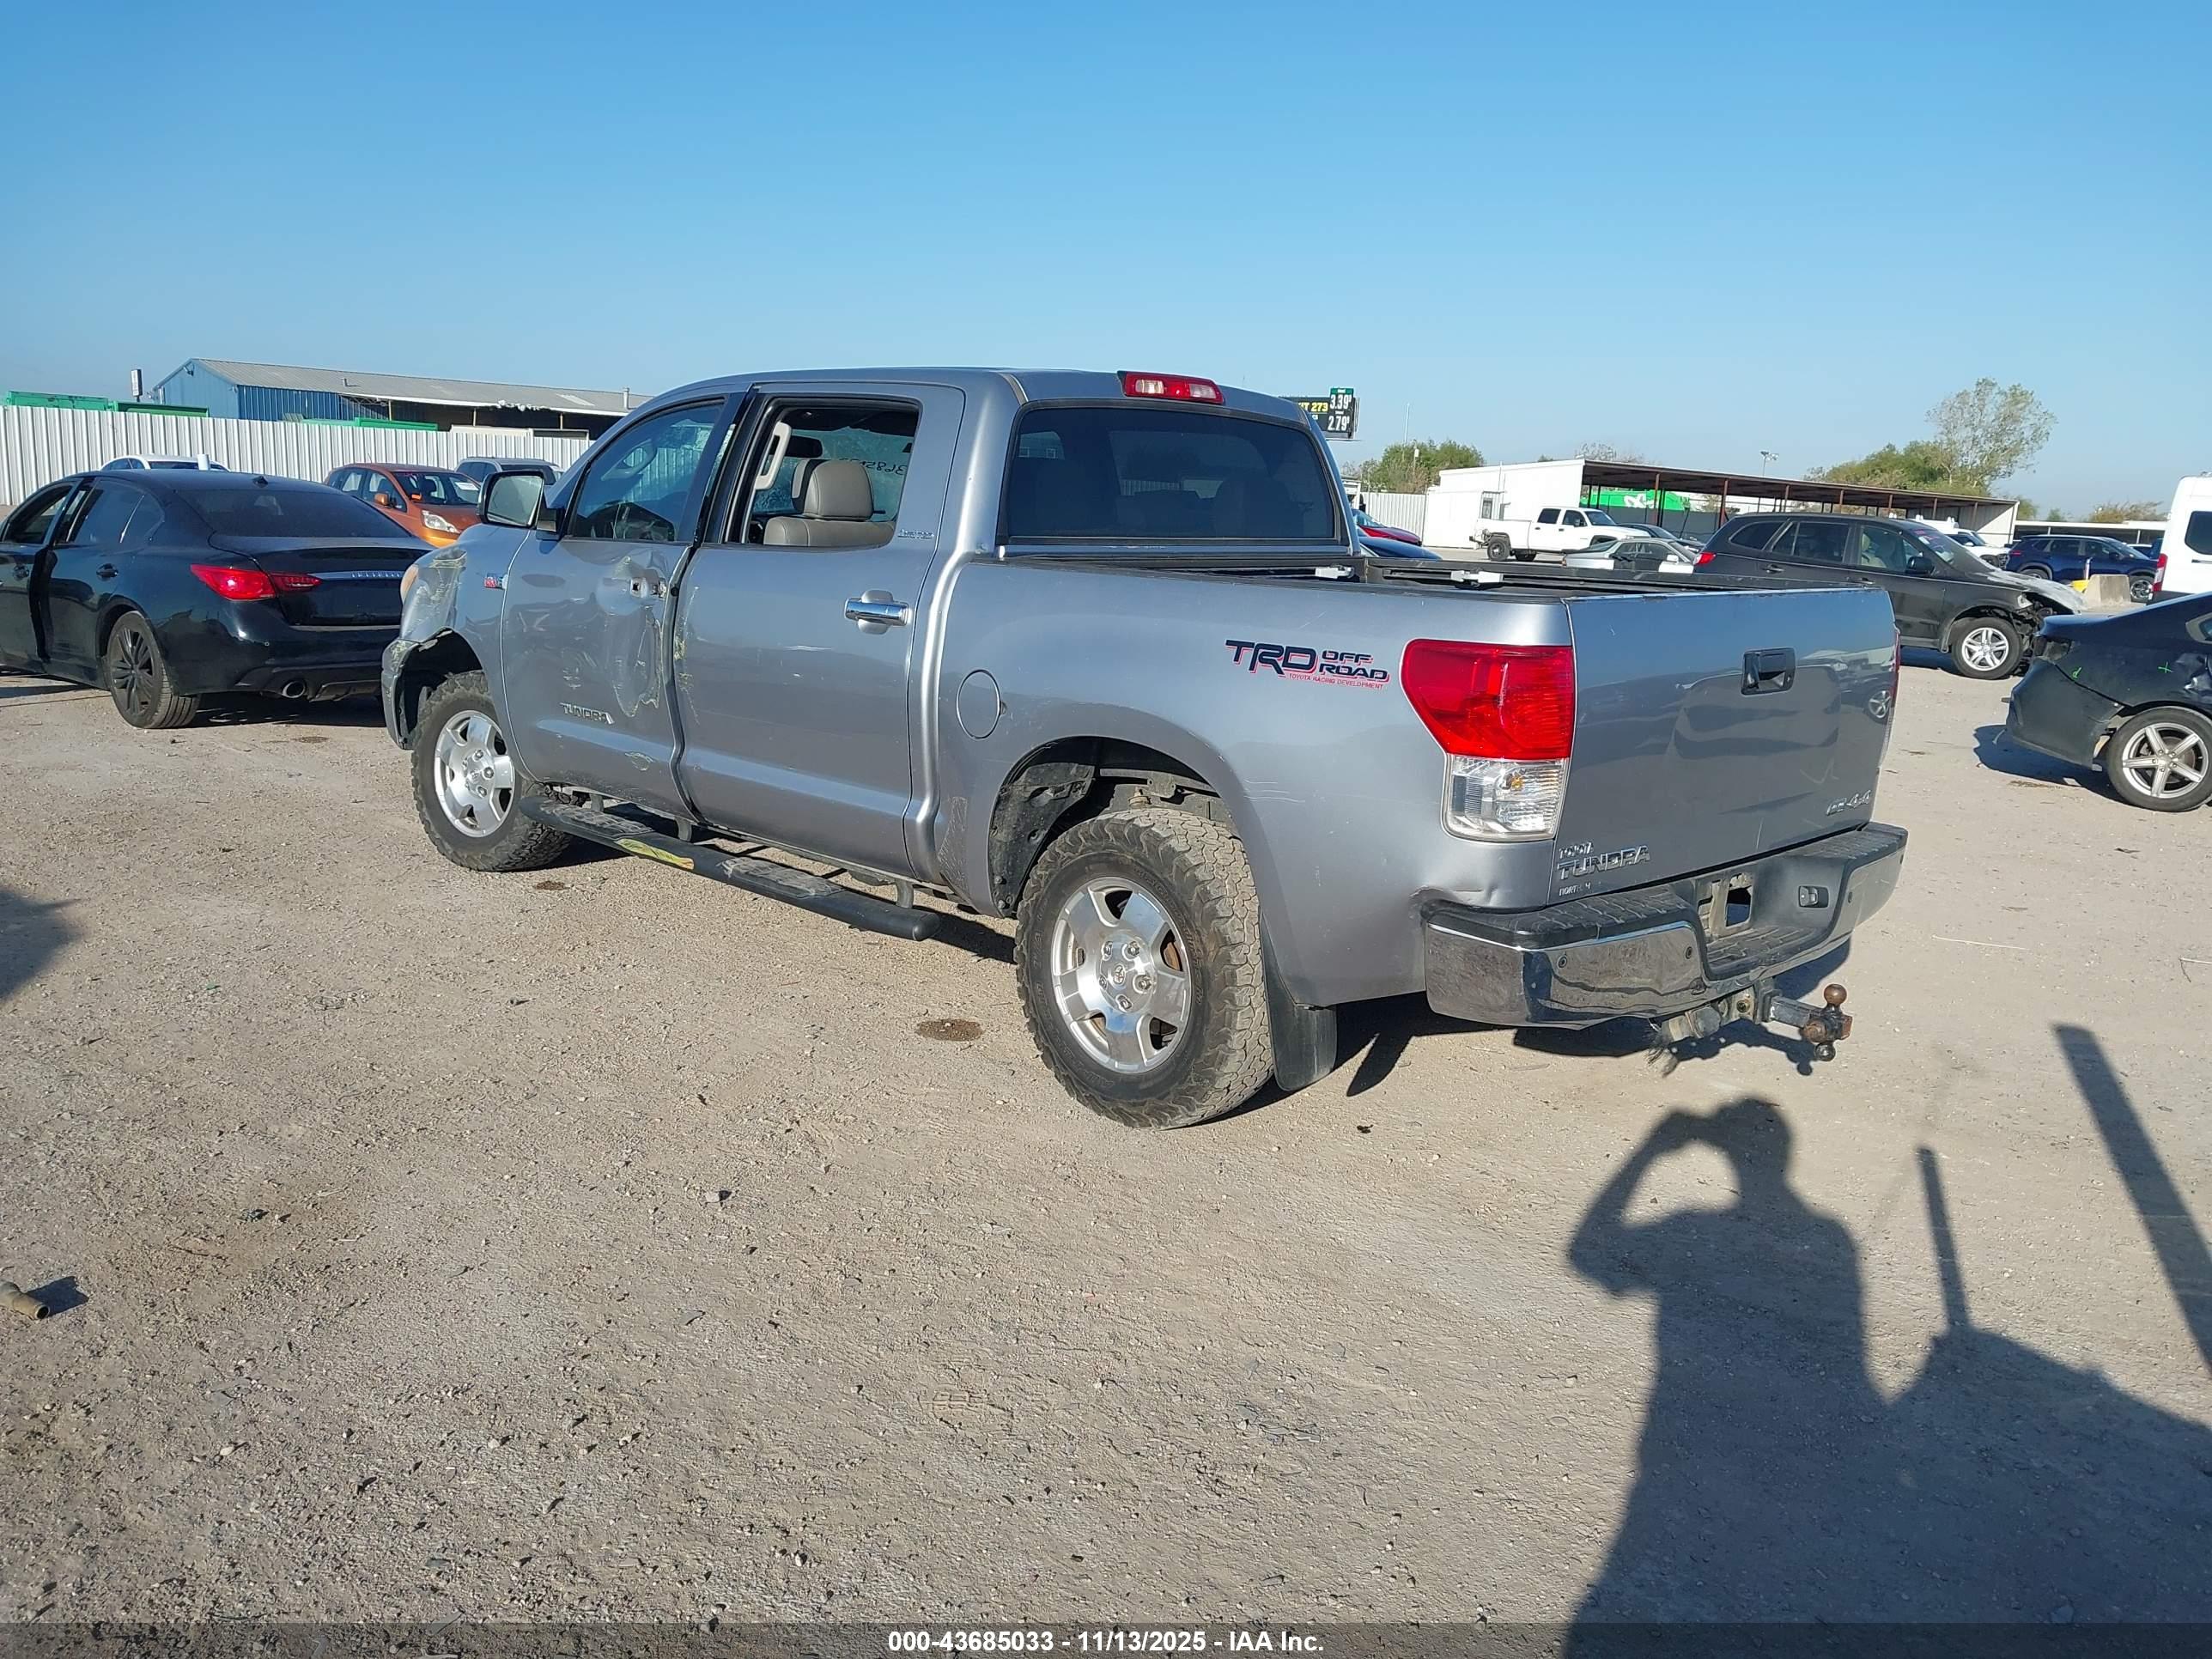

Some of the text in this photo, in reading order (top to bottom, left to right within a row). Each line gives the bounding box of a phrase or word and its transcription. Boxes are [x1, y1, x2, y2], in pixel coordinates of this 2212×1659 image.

[1310, 402, 1328, 412] 273
[1225, 639, 1374, 678] TRD OFF
[1288, 673, 1383, 690] TOYOTA RACING DEVELOPMENT
[1319, 663, 1390, 683] ROAD
[559, 702, 616, 725] TUNDRA
[1557, 846, 1650, 880] TUNDRA
